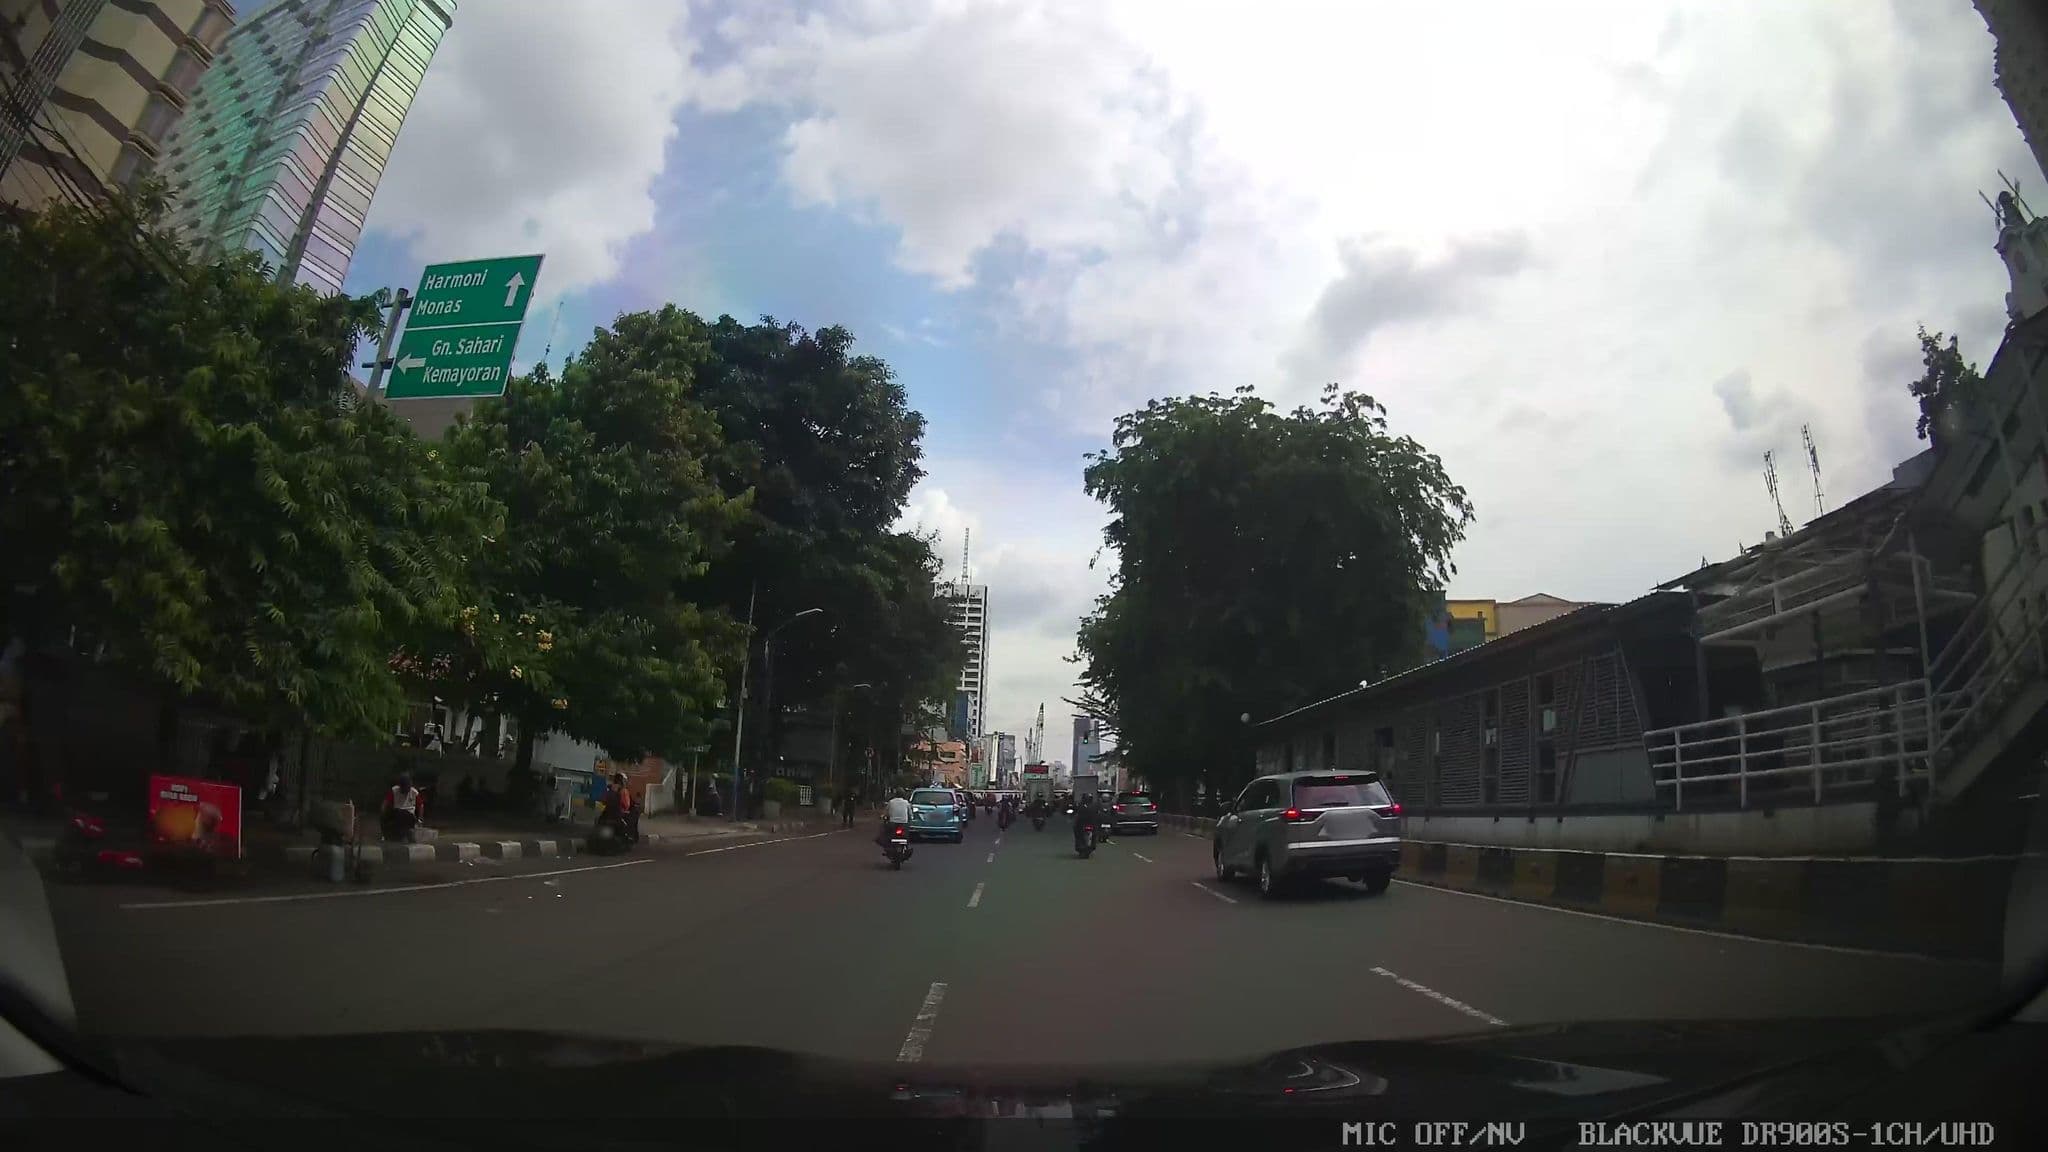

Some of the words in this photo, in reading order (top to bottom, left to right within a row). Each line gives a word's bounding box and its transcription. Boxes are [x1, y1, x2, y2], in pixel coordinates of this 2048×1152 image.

[424, 269, 488, 290] Harmoni
[416, 300, 461, 316] Monas
[432, 340, 452, 356] Gn.
[456, 334, 504, 355] Sahari
[423, 366, 500, 387] Kemayoran
